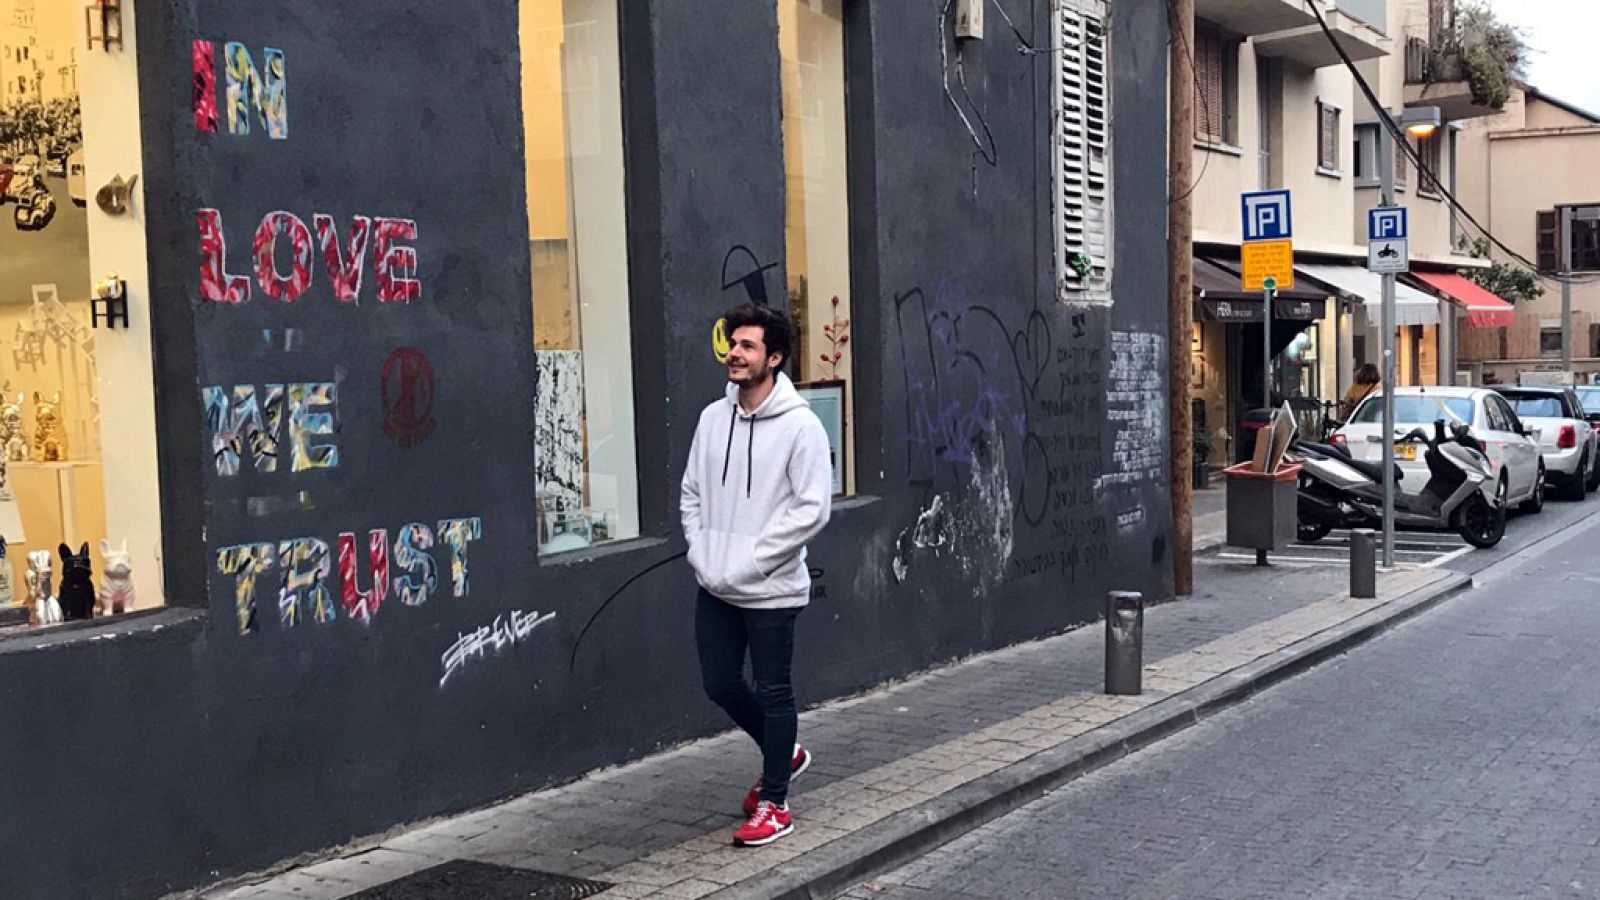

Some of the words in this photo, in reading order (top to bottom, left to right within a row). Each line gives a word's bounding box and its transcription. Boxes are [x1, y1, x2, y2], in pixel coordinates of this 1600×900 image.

[192, 39, 288, 139] IN
[197, 207, 421, 305] LOVE
[1258, 207, 1275, 236] P
[1382, 218, 1393, 237] P
[202, 382, 338, 476] WE
[216, 517, 482, 636] TRUST
